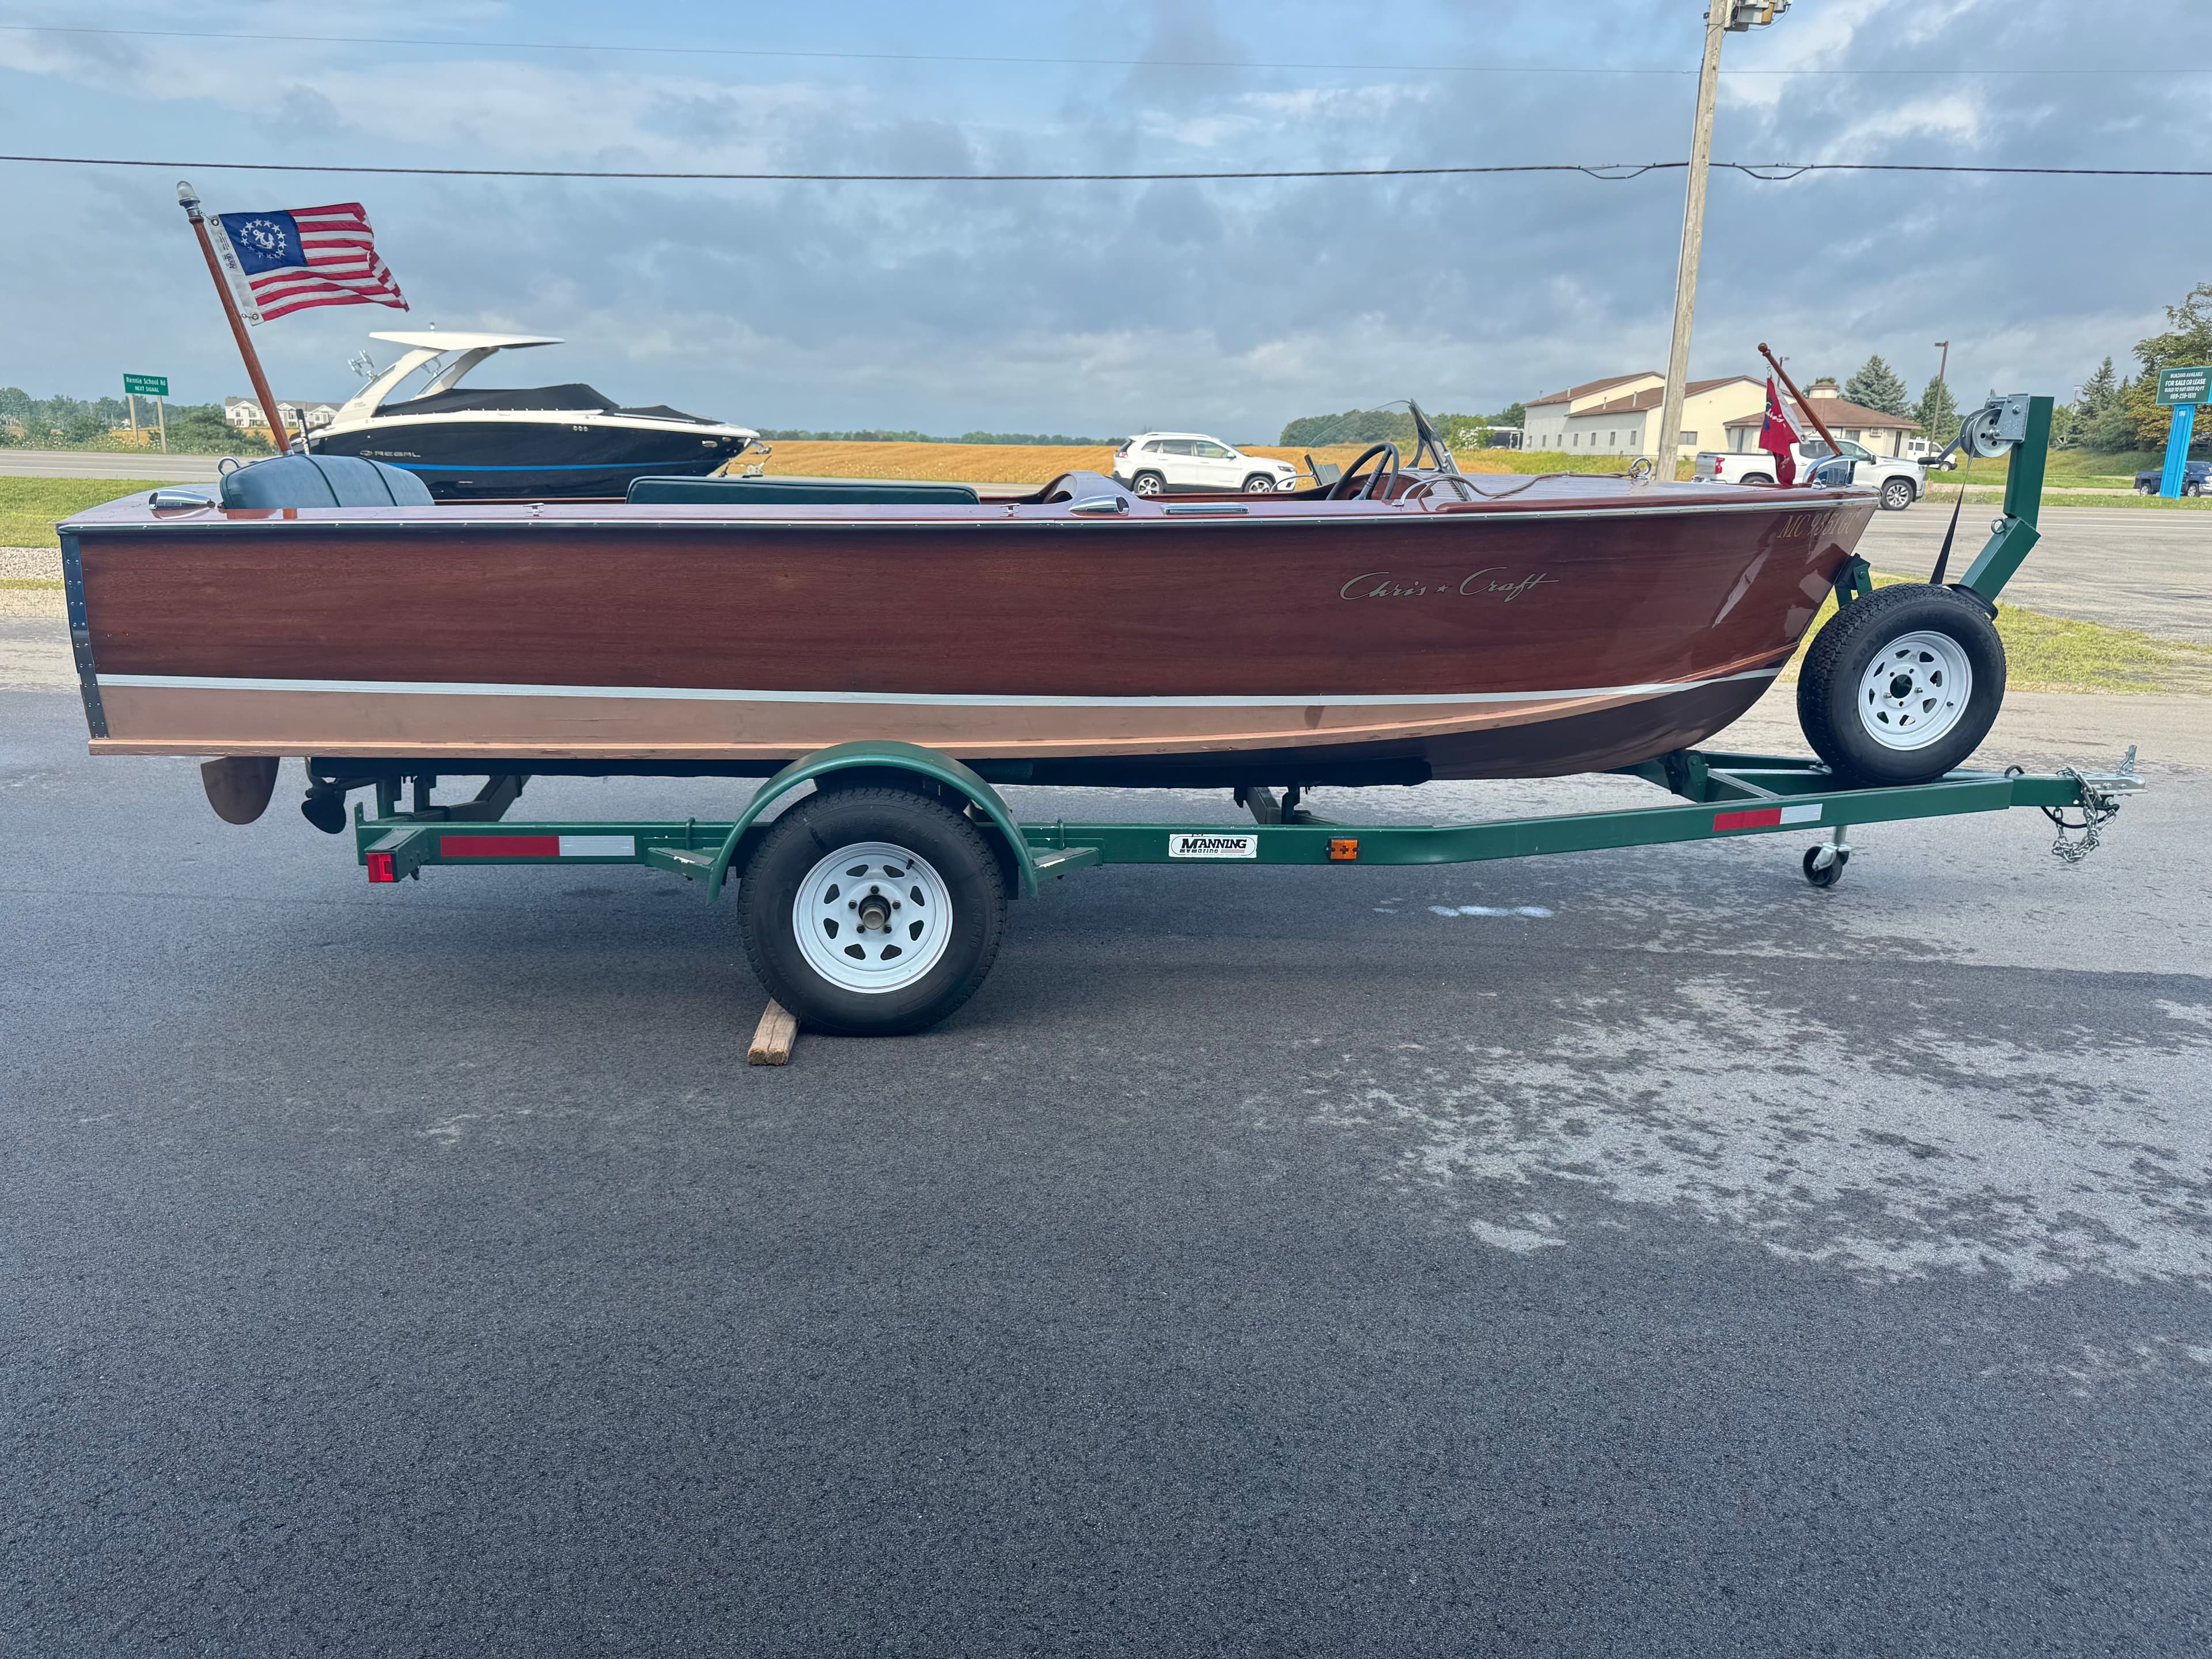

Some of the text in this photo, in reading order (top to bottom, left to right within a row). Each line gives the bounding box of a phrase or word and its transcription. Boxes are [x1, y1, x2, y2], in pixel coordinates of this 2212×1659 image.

[126, 376, 142, 384] Rennie
[1777, 514, 1812, 538] MC
[1340, 566, 1559, 603] Chris Craft
[1181, 838, 1247, 849] MANNING
